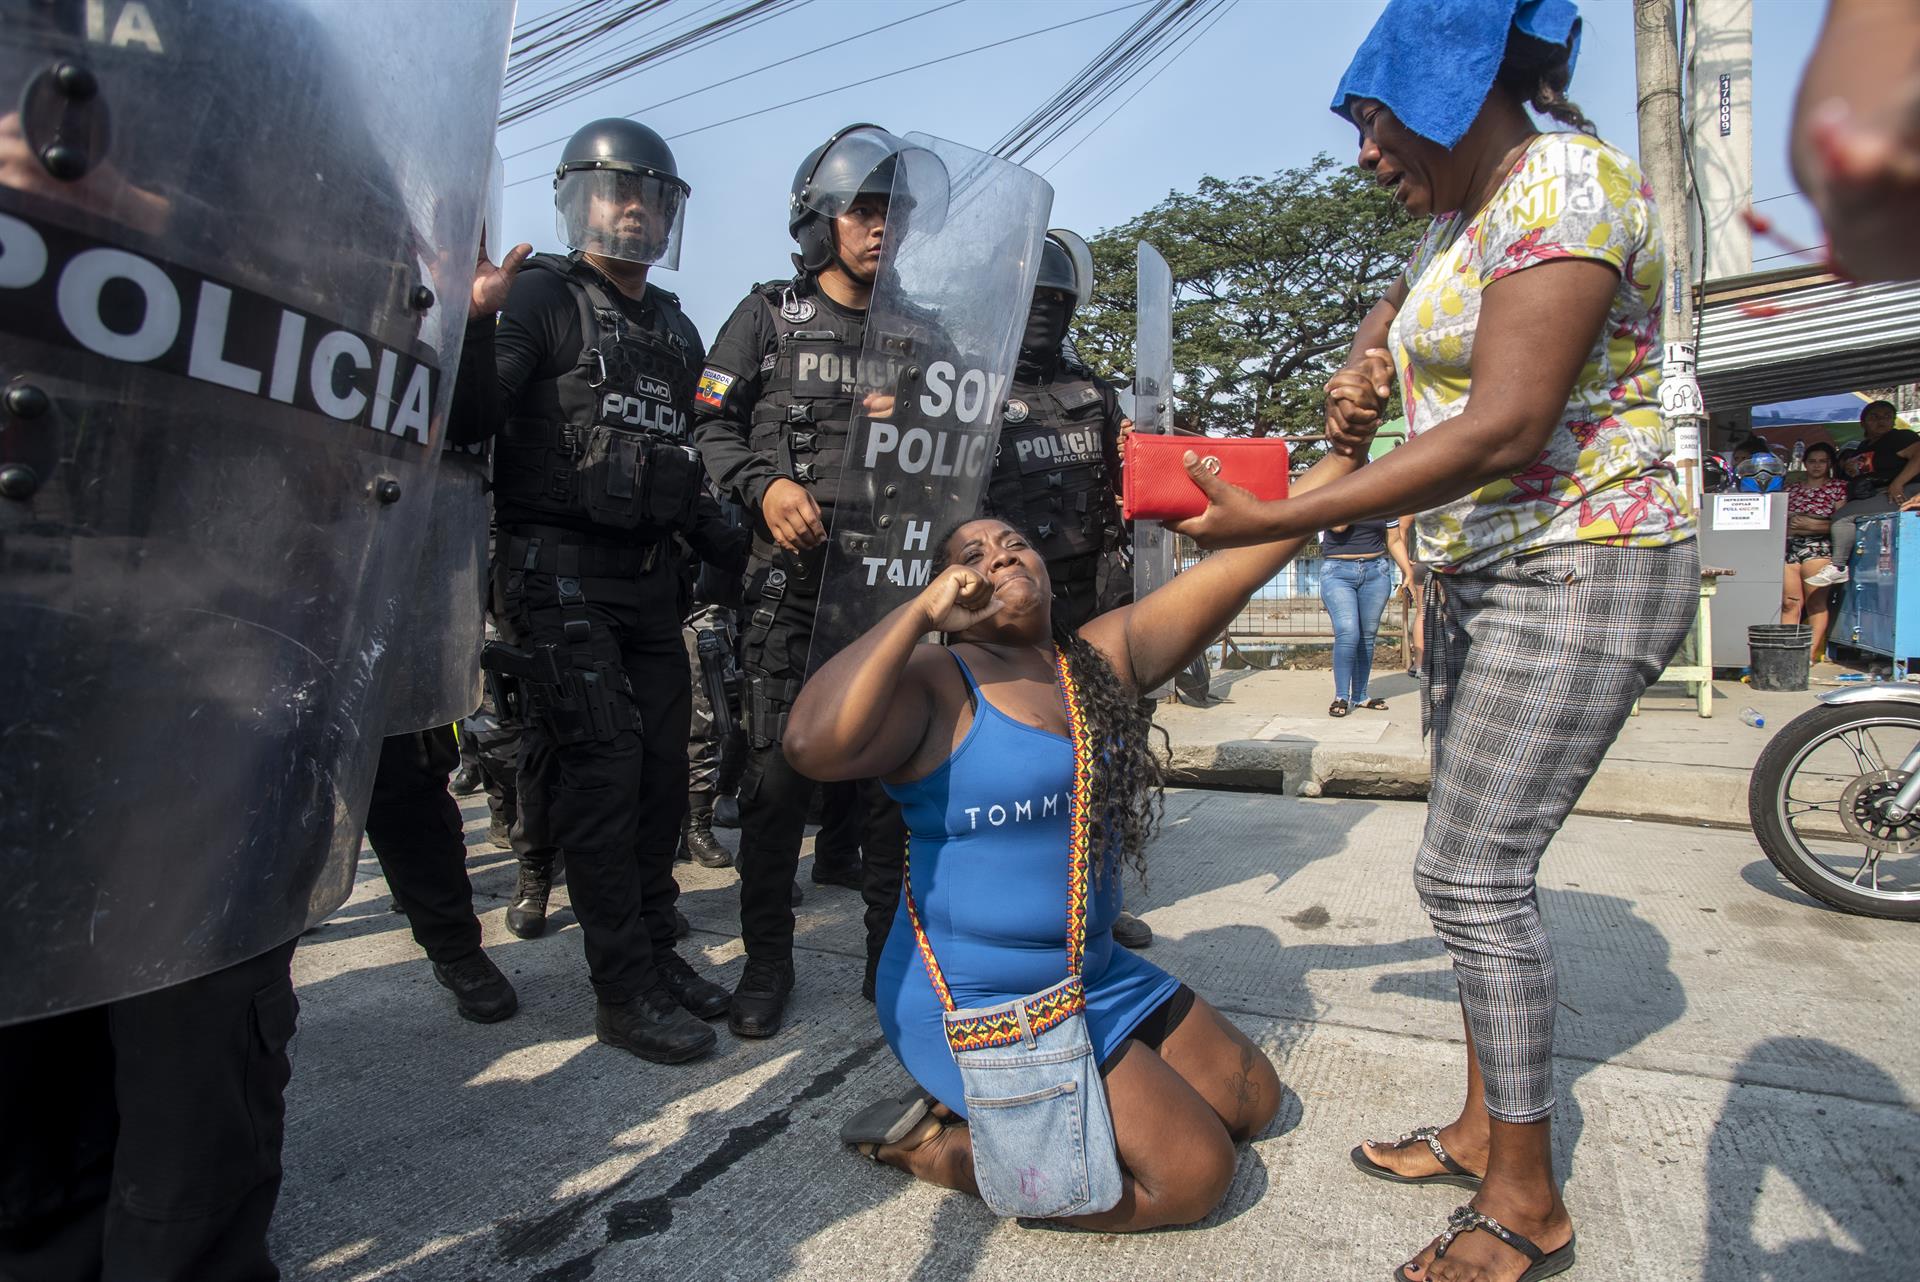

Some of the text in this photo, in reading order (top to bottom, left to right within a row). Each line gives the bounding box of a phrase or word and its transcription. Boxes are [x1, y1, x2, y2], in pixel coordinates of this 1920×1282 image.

[1721, 80, 1730, 130] 170009
[603, 393, 687, 440] POLICIA
[920, 361, 1005, 424] SOY
